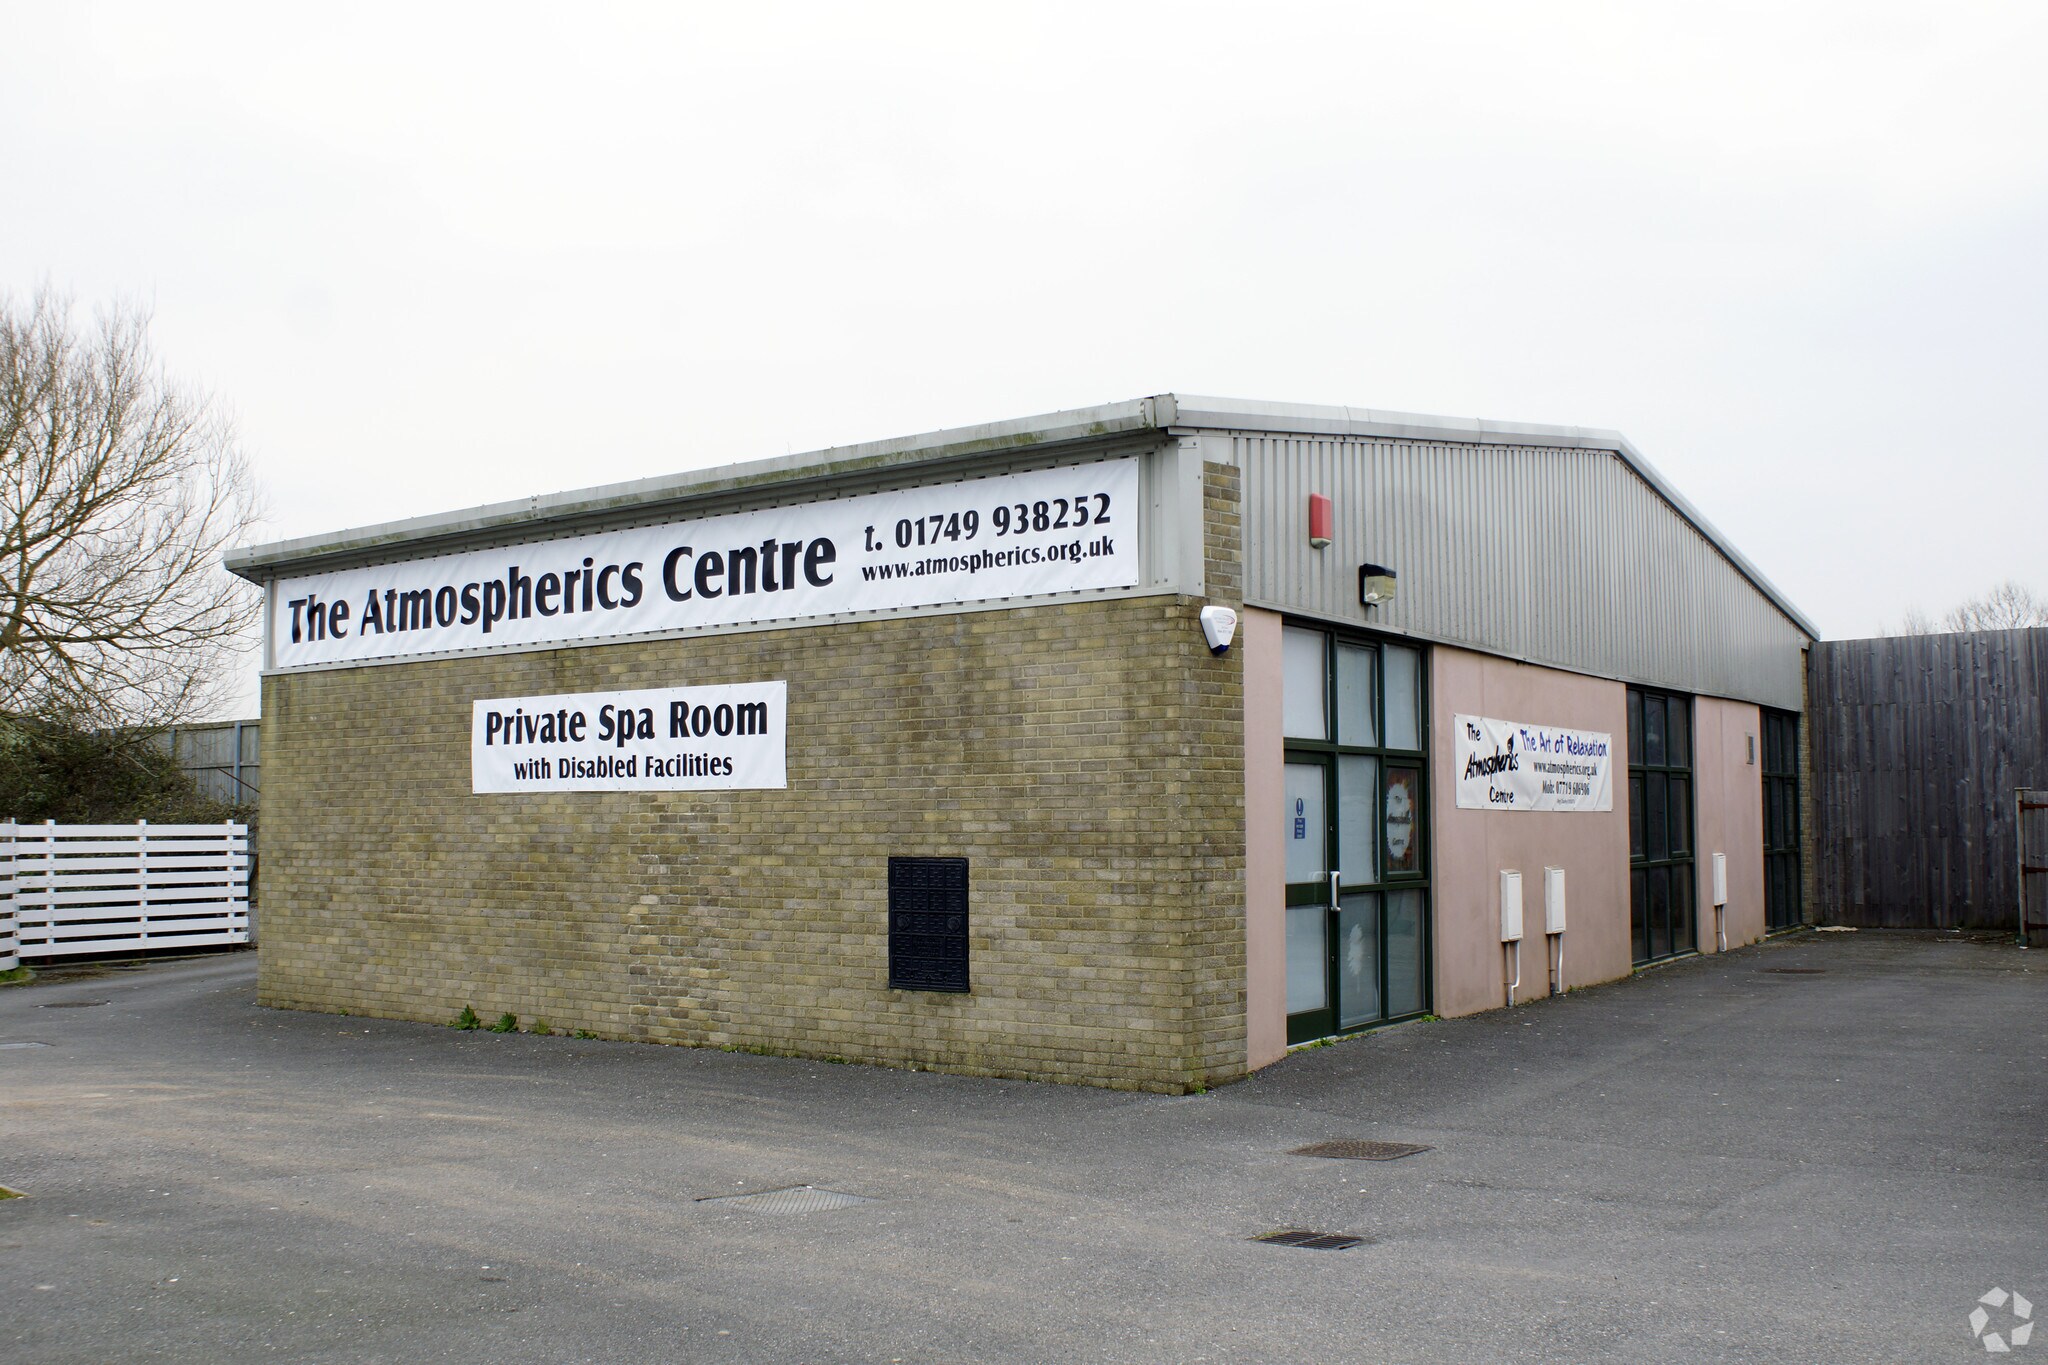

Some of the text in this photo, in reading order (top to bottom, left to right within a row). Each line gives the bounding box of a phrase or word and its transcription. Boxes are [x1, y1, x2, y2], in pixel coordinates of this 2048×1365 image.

[865, 492, 1111, 552] t. 01749 938252
[862, 536, 1114, 581] www.atmospherics.org.uk
[288, 537, 836, 643] The Atmospherics Centre
[486, 700, 768, 748] Private Spa Room
[1467, 723, 1481, 742] The
[1520, 728, 1608, 758] The Art of Relaxation
[514, 752, 733, 780] with Disabled Facilities
[1533, 761, 1598, 780] www.atmospherics.org.uk
[1489, 785, 1514, 804] Centre
